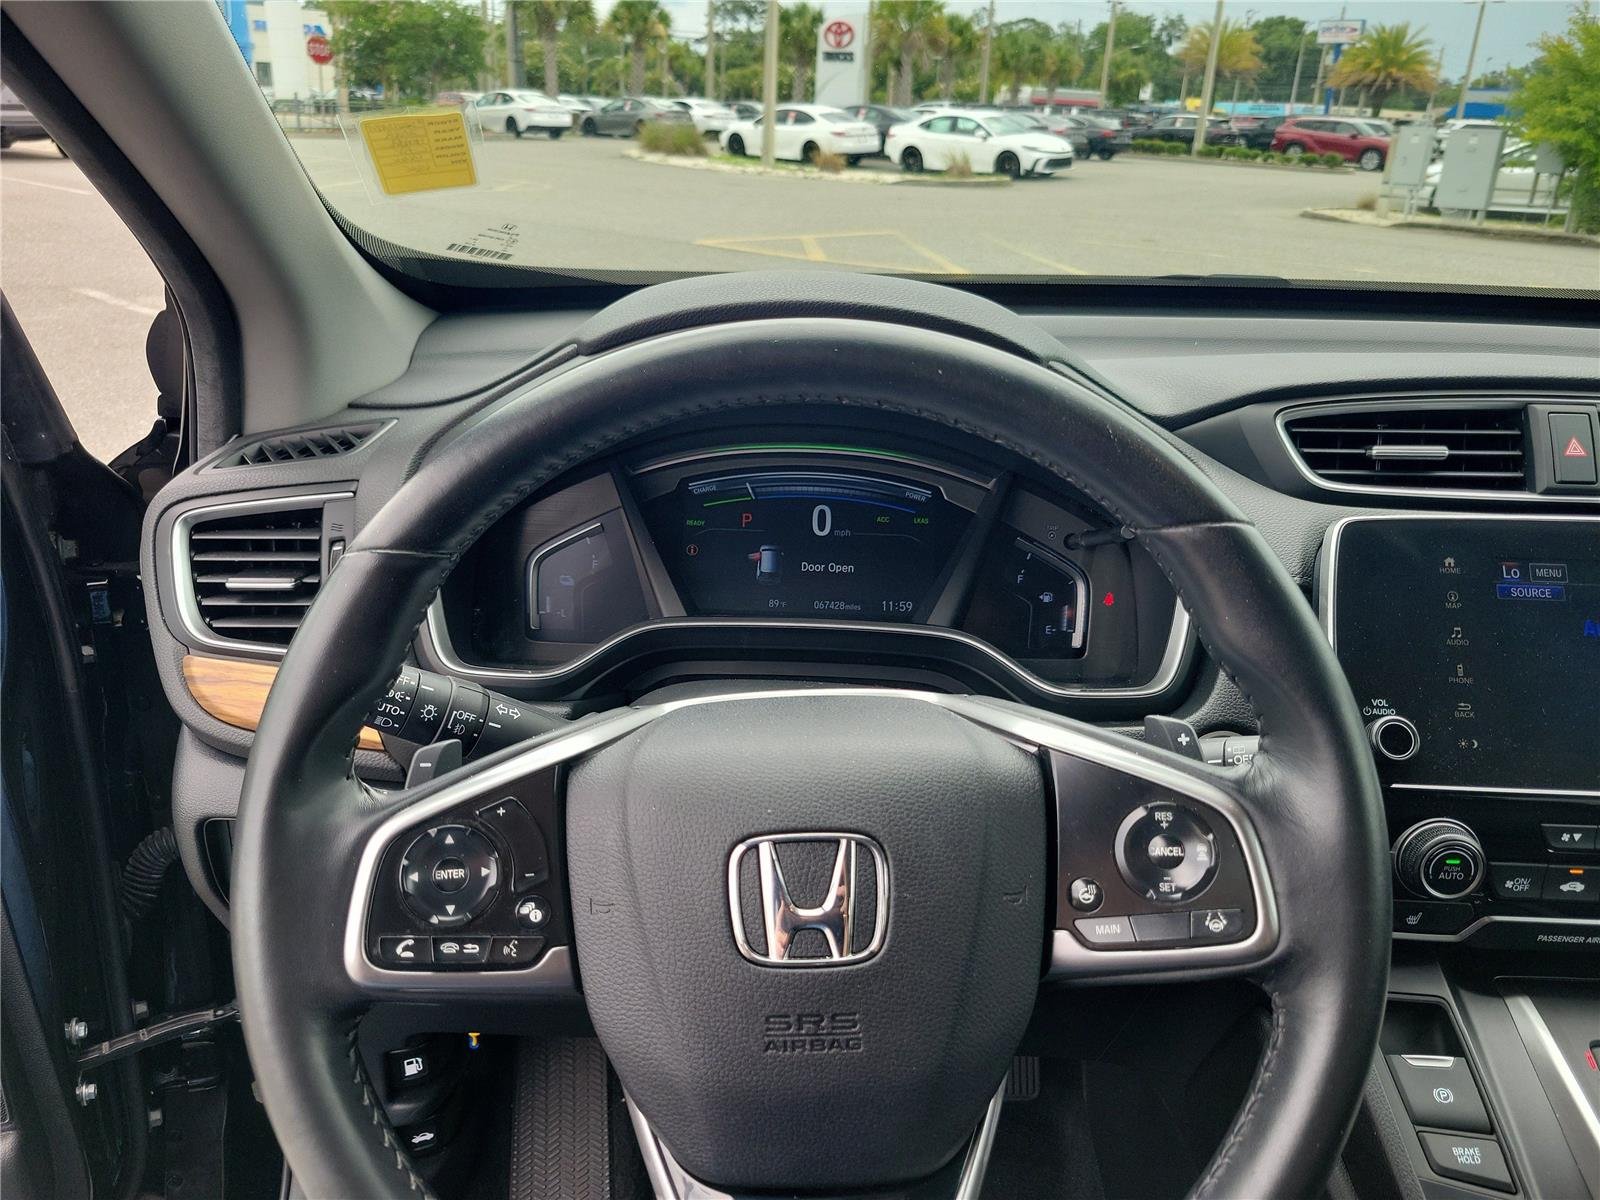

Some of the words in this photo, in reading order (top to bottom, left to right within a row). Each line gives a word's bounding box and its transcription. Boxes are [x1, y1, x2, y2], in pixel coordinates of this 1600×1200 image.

[693, 485, 717, 494] CHARGE
[905, 491, 926, 502] POWER
[686, 519, 705, 527] READY
[742, 513, 753, 528] P
[812, 504, 832, 537] 0
[834, 529, 851, 538] mph
[876, 515, 890, 523] ACC
[913, 516, 929, 525] LKAS
[801, 561, 825, 572] Door
[828, 561, 855, 574] Open
[1439, 567, 1462, 575] HOME
[1535, 568, 1563, 578] MENU
[1510, 587, 1553, 599] SOURCE
[881, 601, 913, 612] 11:59
[1446, 638, 1470, 646] AUDIO
[1448, 676, 1474, 685] PHONE
[1371, 698, 1389, 707] VOL
[456, 709, 477, 723] OFF
[1372, 708, 1396, 716] AUDIO
[1454, 711, 1475, 719] BACK
[1154, 811, 1174, 822] RES
[1149, 846, 1185, 857] CANCEL
[435, 868, 465, 881] ENTER
[1438, 872, 1464, 880] AUTO
[1159, 882, 1177, 893] SET
[1512, 884, 1531, 892] OFF
[1095, 924, 1121, 936] MAIN
[1536, 934, 1585, 944] PASSENGER
[764, 1012, 861, 1034] SRS
[764, 1038, 864, 1055] AIRBAG
[1452, 1147, 1480, 1156] BRAKE
[1458, 1155, 1481, 1164] HOLD
